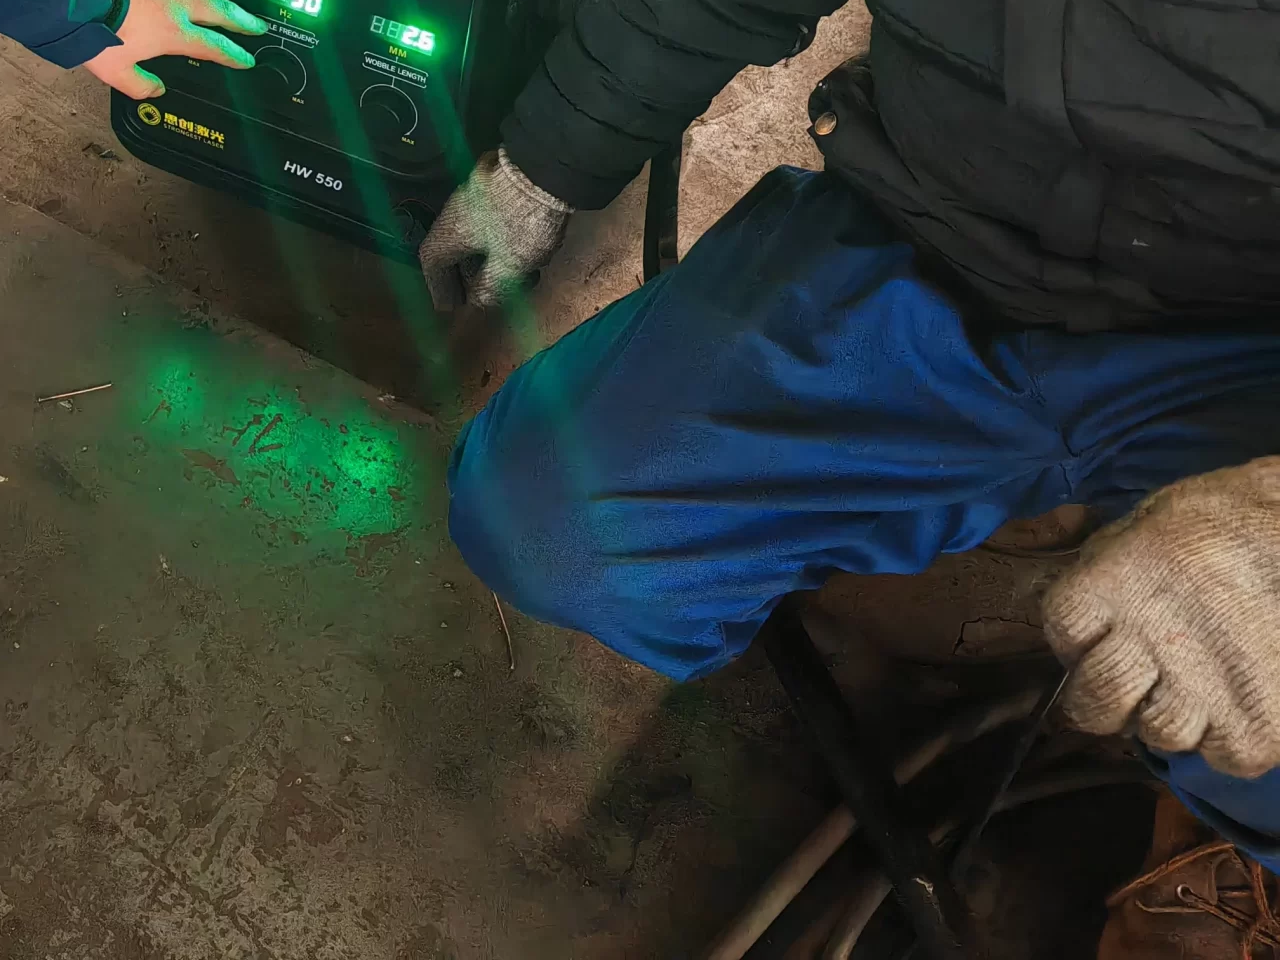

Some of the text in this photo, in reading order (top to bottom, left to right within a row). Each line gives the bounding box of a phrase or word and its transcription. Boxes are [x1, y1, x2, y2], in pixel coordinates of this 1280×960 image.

[279, 8, 292, 19] Hz
[279, 26, 320, 46] FREQUENCY
[388, 45, 407, 58] MM
[365, 56, 427, 83] WOBBLE LENGTH
[291, 96, 304, 104] MAX
[163, 123, 224, 150] STRONGEST LASER
[401, 136, 415, 145] MAX
[283, 160, 343, 191] HW 550
